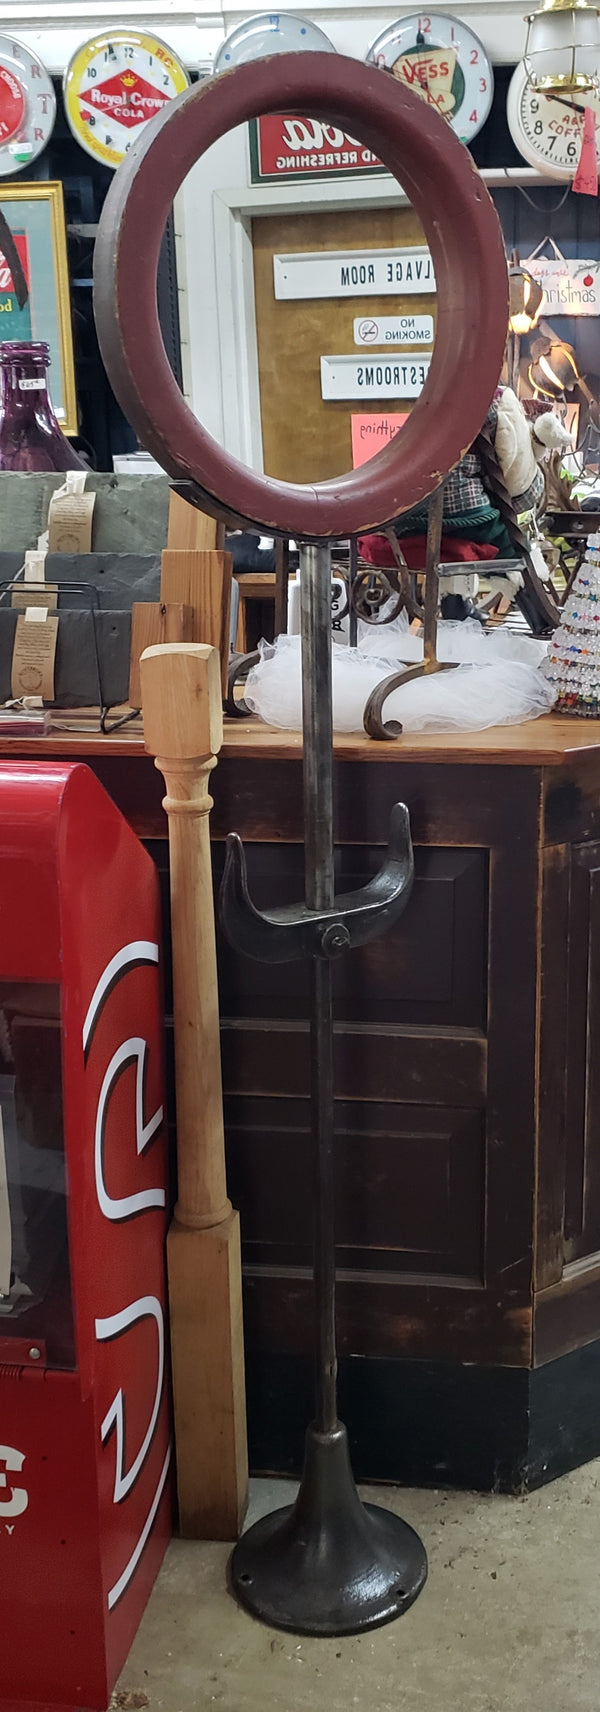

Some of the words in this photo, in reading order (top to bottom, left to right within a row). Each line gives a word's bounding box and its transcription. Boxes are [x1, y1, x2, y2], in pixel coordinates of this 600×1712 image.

[418, 18, 431, 32] 12
[124, 47, 134, 58] 12
[470, 50, 478, 64] 2
[88, 68, 97, 78] 10
[163, 75, 169, 85] 2
[479, 78, 487, 92] 3
[91, 88, 127, 106] Royal
[427, 94, 445, 104] LA
[114, 107, 145, 118] COLA
[530, 99, 539, 114] 9
[469, 110, 478, 123] 4
[534, 120, 543, 135] 8
[547, 136, 557, 150] 7
[567, 142, 577, 156] 6
[540, 279, 596, 303] hristmas
[0, 299, 12, 312] od
